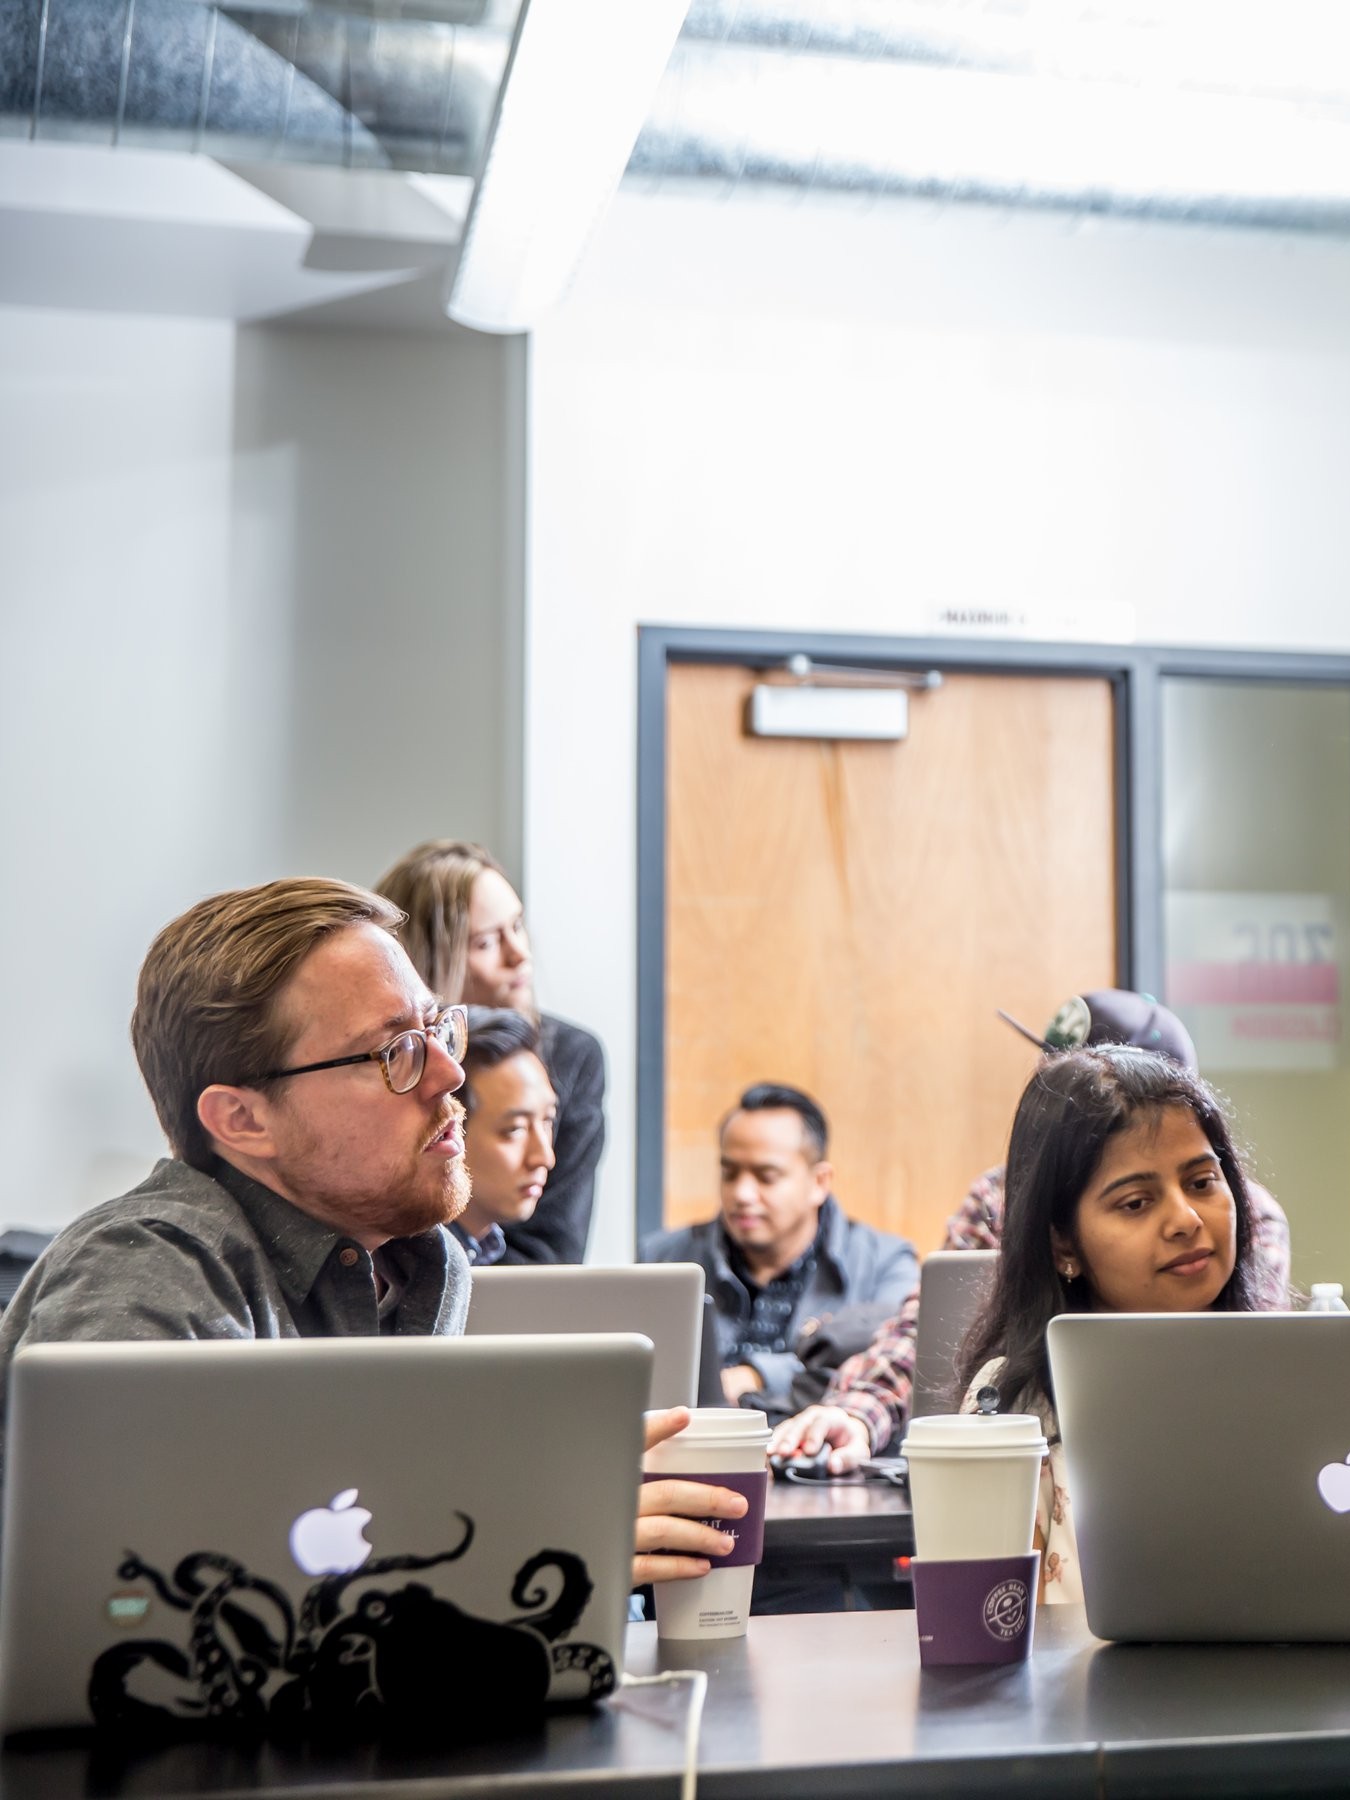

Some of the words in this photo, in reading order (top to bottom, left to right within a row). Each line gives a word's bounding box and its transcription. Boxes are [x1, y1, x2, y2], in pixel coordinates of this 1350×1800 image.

[987, 1585, 1006, 1614] COFFEE
[1009, 1584, 1024, 1596] BEAN
[1001, 1627, 1013, 1636] TEA
